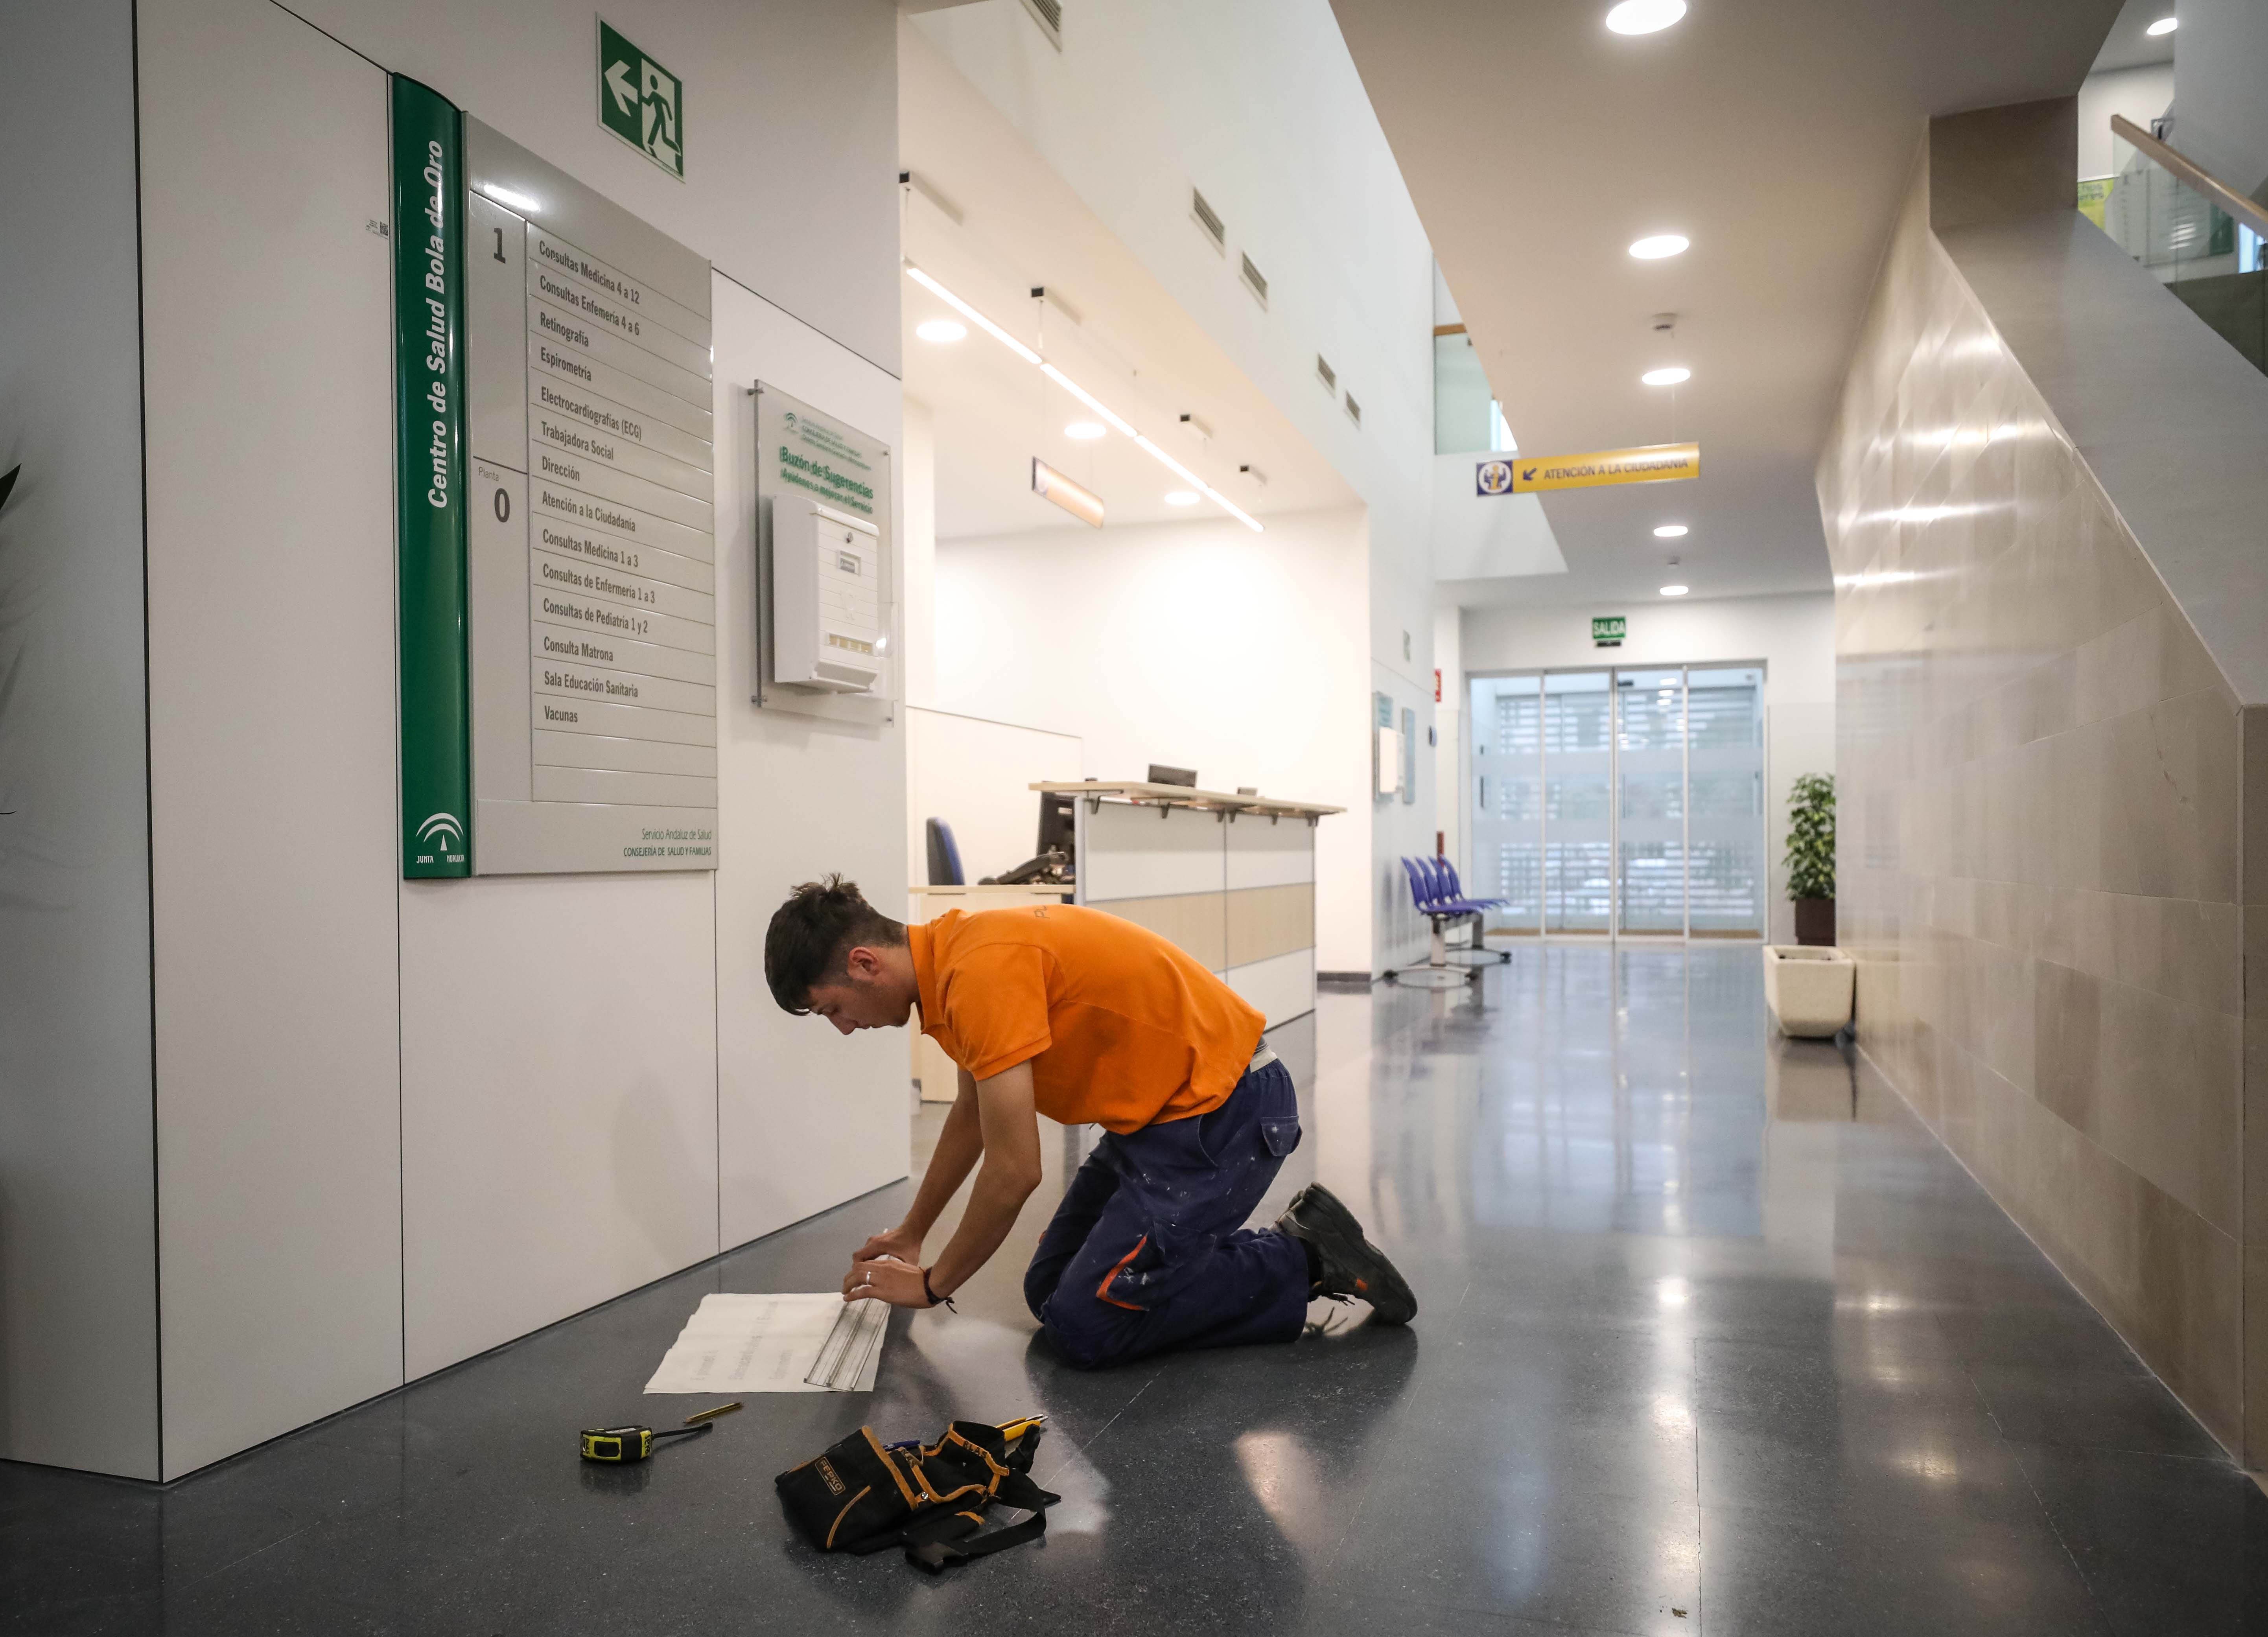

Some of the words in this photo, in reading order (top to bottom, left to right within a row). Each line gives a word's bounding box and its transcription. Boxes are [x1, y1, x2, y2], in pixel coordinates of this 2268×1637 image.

[424, 140, 442, 189] Oro
[425, 196, 443, 228] de
[494, 228, 506, 264] 1
[425, 235, 444, 294] Bola
[540, 240, 579, 273] Consultas
[581, 261, 615, 292] Medicina
[617, 282, 622, 295] 4
[624, 288, 628, 299] a
[631, 289, 640, 304] 12
[540, 275, 579, 306] Consultas
[621, 316, 626, 329] 4
[628, 322, 632, 332] a
[635, 322, 639, 335] 6
[426, 297, 445, 374] Salud
[540, 311, 589, 347] Retinografía
[541, 346, 591, 381] Espirometría
[427, 381, 446, 413] de
[541, 386, 619, 431] Electrocardiografías
[621, 418, 641, 442] (ECG)
[541, 420, 589, 451] Trabajadora
[591, 440, 614, 460] Social
[428, 420, 447, 508] Centro
[479, 467, 499, 481] Planta
[542, 455, 580, 481] Dirección
[781, 446, 810, 471] Buzón
[812, 461, 822, 477] de
[824, 466, 873, 499] Sugerencias
[1544, 464, 1595, 479] ATENCIÓN
[1599, 464, 1605, 475] A
[1608, 464, 1621, 474] LA
[494, 488, 510, 523] 0
[542, 491, 577, 514] Atención
[579, 505, 584, 516] a
[586, 504, 593, 519] la
[595, 507, 636, 532] Ciudadanía
[543, 528, 582, 552] Consultas
[584, 540, 618, 562] Medicina
[621, 551, 625, 564] 1
[627, 555, 631, 566] a
[634, 554, 638, 567] 3
[543, 563, 582, 586] Consultas
[584, 574, 593, 588] de
[596, 576, 636, 598] Enfermería
[638, 587, 642, 600] 1
[645, 592, 649, 602] a
[650, 591, 655, 604] 3
[544, 598, 582, 620] Consultas
[585, 608, 594, 622] de
[596, 609, 628, 629] Pediatría
[631, 617, 635, 630] 1
[637, 624, 641, 635] y
[643, 620, 648, 633] 2
[1594, 621, 1625, 635] SALIDA
[544, 636, 579, 655] Consulta
[581, 643, 614, 661] Matrona
[544, 671, 562, 687] Sala
[564, 674, 604, 693] Educación
[606, 680, 638, 698] Sanitaria
[544, 705, 578, 723] Vacunas
[624, 845, 657, 856] CONSEJERÍA
[658, 847, 665, 856] DE
[667, 847, 684, 856] SALUD
[685, 847, 688, 855] Y
[689, 847, 711, 855] FAMILIAS
[642, 828, 664, 840] Servicio
[665, 829, 688, 840] Andaluz
[689, 829, 696, 840] de
[697, 829, 711, 840] Salud
